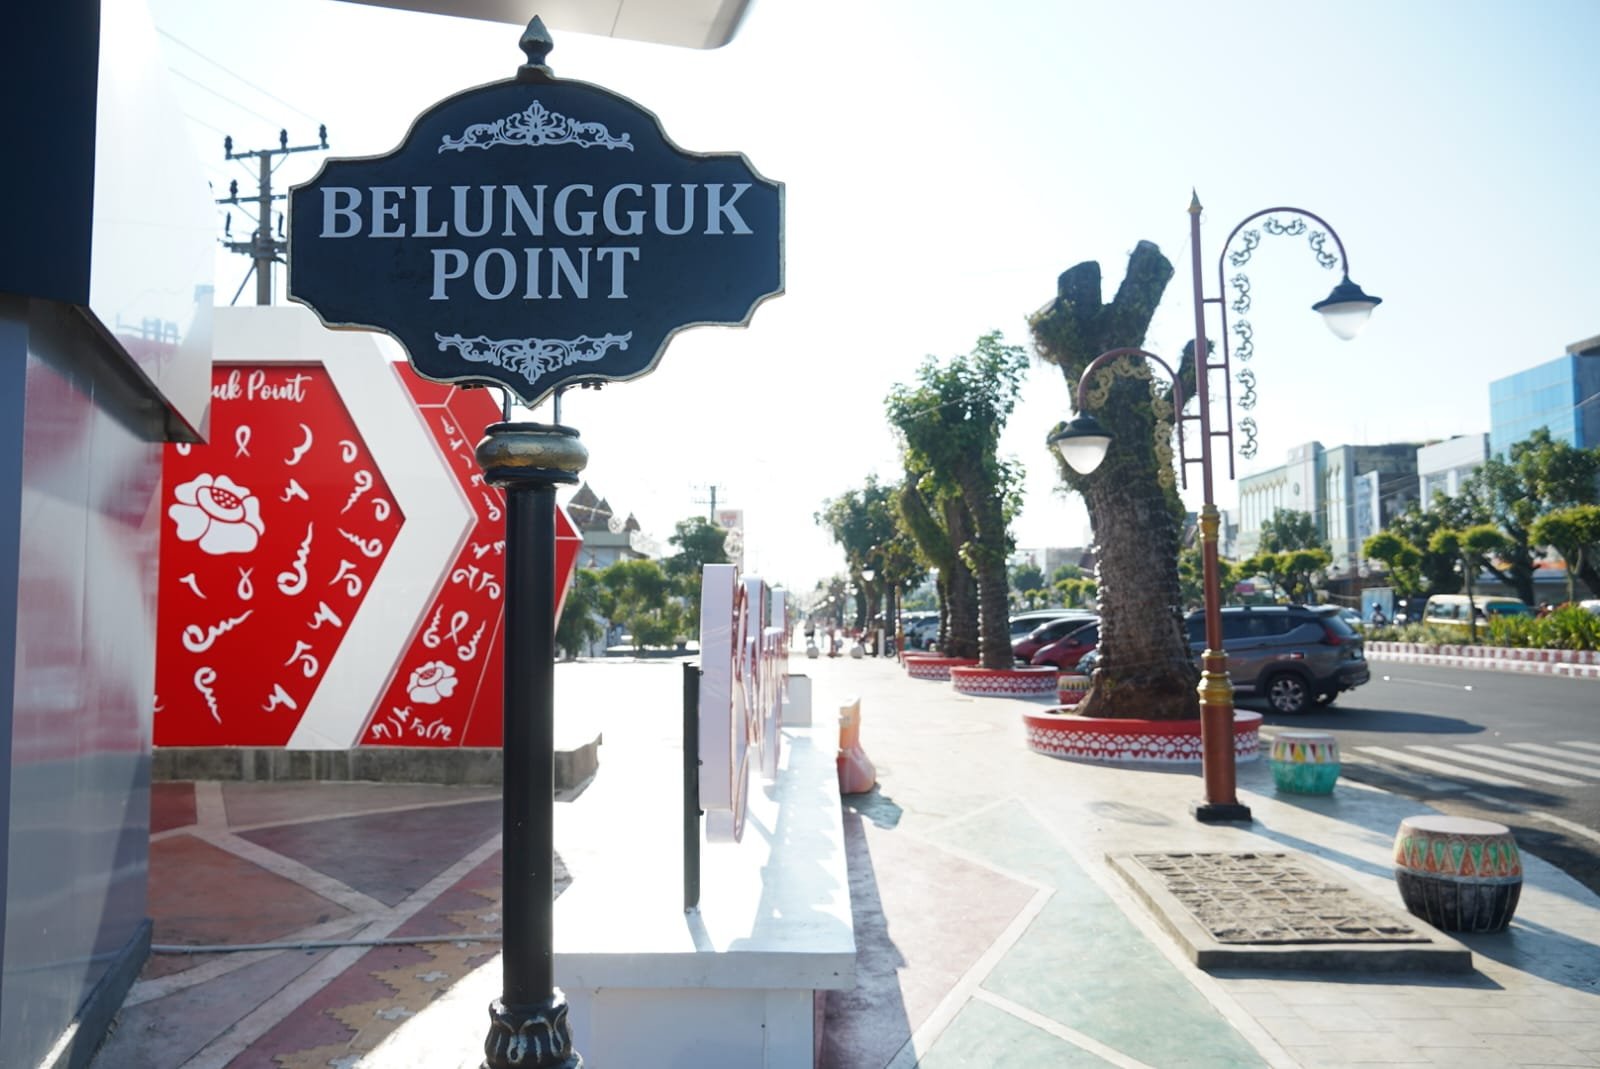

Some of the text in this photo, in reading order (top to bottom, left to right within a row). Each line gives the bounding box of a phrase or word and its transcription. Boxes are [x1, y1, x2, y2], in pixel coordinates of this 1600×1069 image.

[319, 182, 754, 239] BELUNGGUK
[429, 245, 641, 302] POINT
[247, 369, 313, 403] Point
